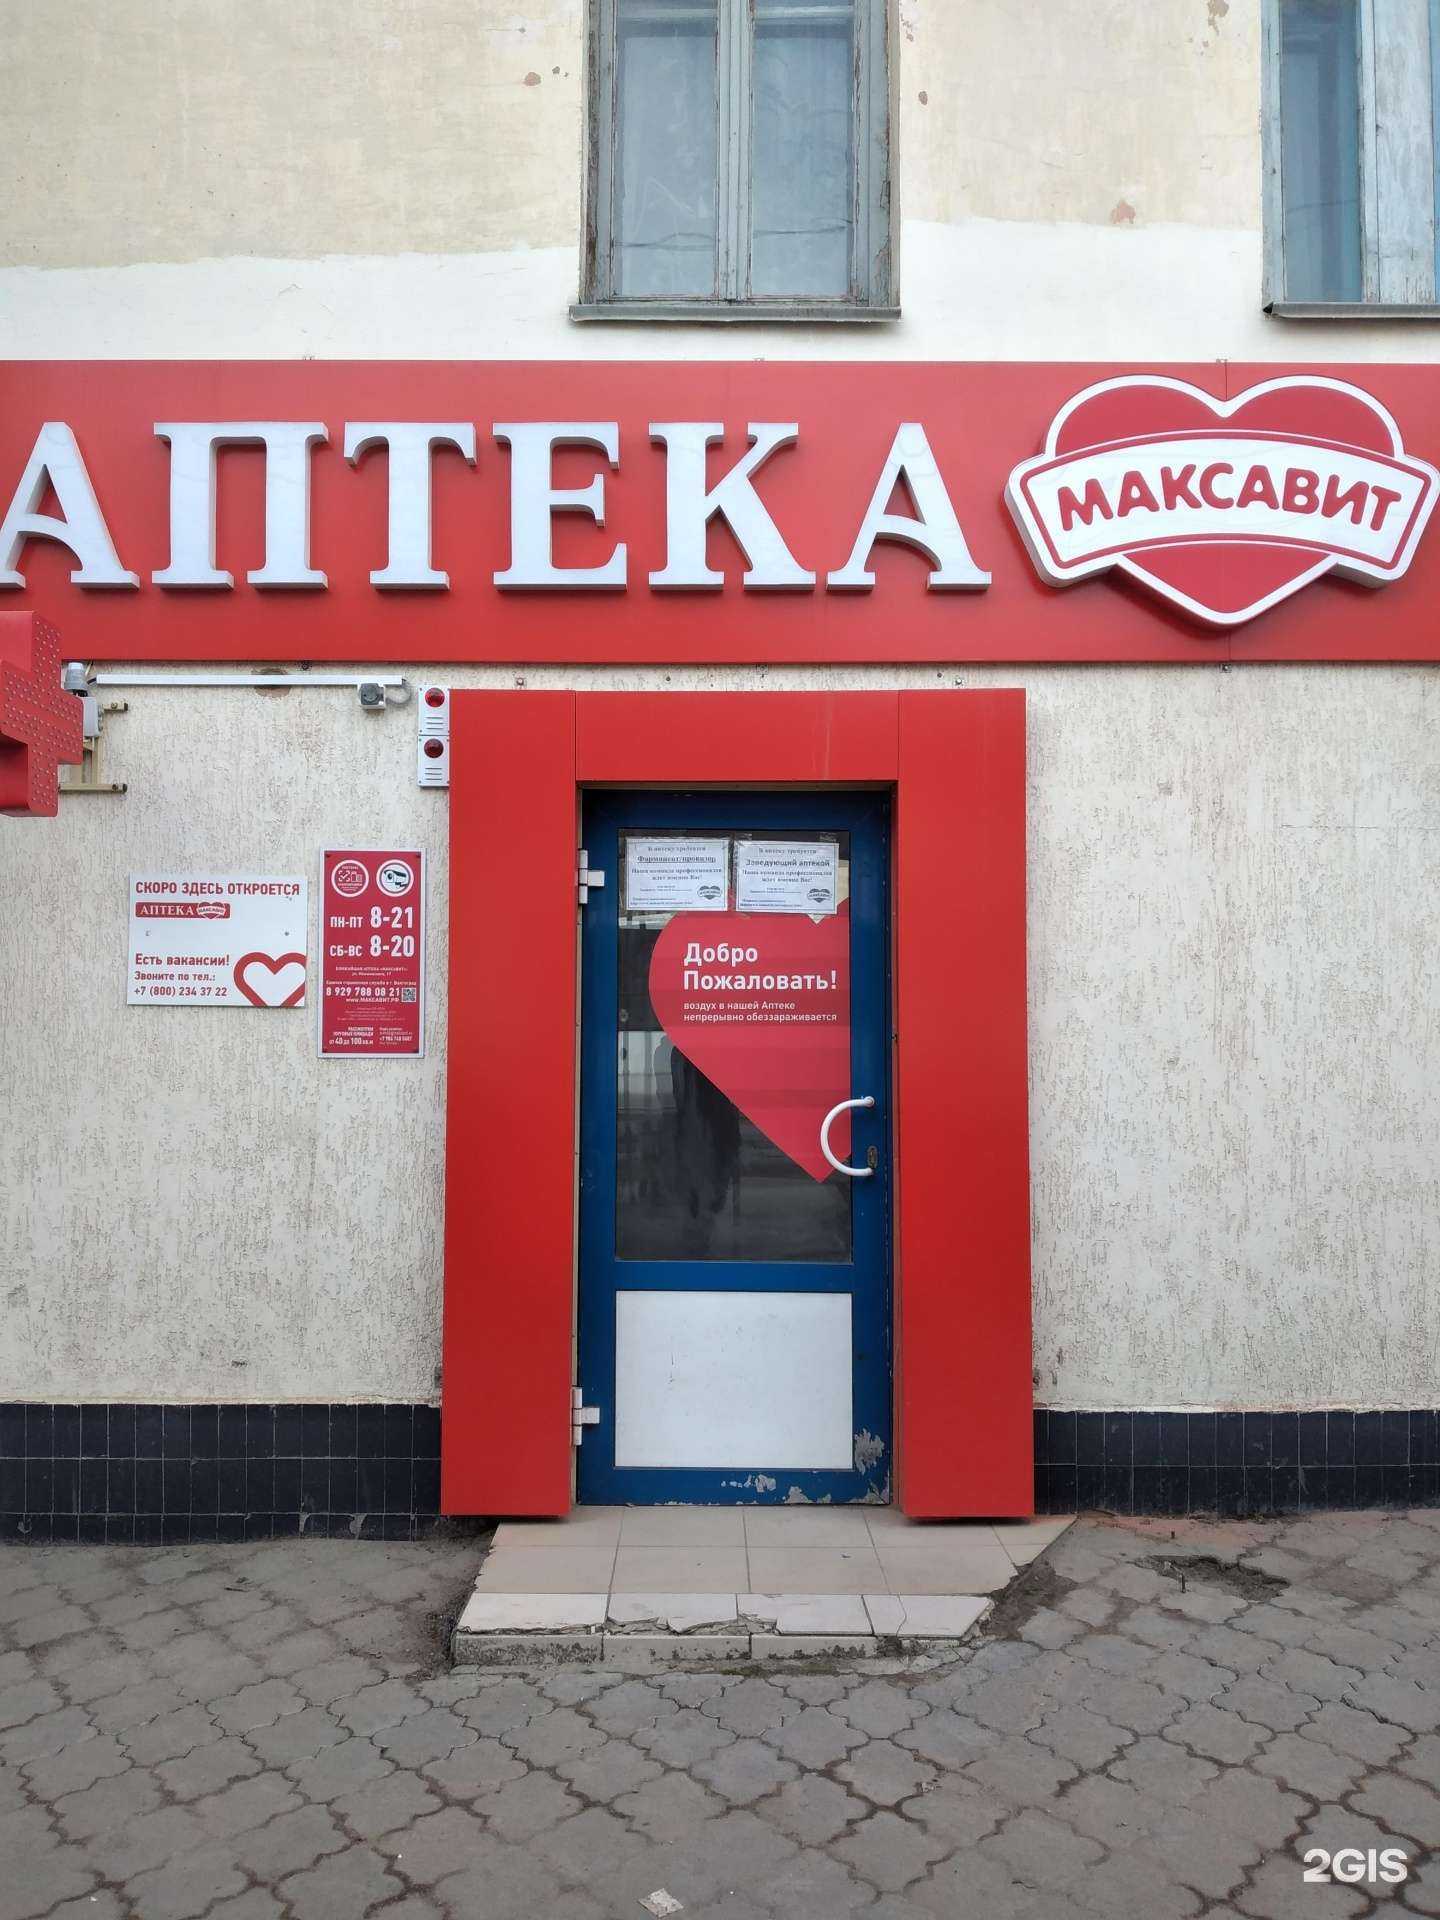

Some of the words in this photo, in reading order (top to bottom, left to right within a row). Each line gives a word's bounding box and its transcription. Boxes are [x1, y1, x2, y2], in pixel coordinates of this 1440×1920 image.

[1057, 463, 1402, 532] МАКСАВИТ
[0, 421, 992, 591] АПТЕКА
[135, 881, 177, 894] СКОРО
[181, 882, 224, 896] ЗДЕСЬ
[228, 883, 300, 895] ОТКРОЕТСЯ
[139, 904, 195, 916] АПТЕКА
[330, 916, 363, 928] ПН-ПТ
[370, 906, 413, 929] 8-21
[330, 945, 362, 957] СБ-ВС
[370, 934, 414, 957] 8-20
[135, 953, 163, 966] Есть
[166, 954, 230, 966] вакансии!
[683, 942, 759, 967] Добро
[134, 970, 175, 981] Звоните
[178, 973, 189, 981] по
[192, 973, 216, 981] тел.:
[683, 970, 837, 990] Пожаловать!
[134, 987, 146, 996] +7
[149, 986, 176, 997] (800)
[179, 987, 197, 996] 234
[200, 987, 211, 996] 37
[215, 987, 227, 997] 22
[326, 987, 332, 996] 8
[335, 987, 352, 996] 929
[389, 987, 400, 996] 21
[683, 1002, 717, 1011] воздух
[727, 1001, 759, 1010] нашей
[761, 1001, 795, 1010] Аптеке
[683, 1013, 745, 1023] непрерывно
[746, 1013, 837, 1023] обеззараживается
